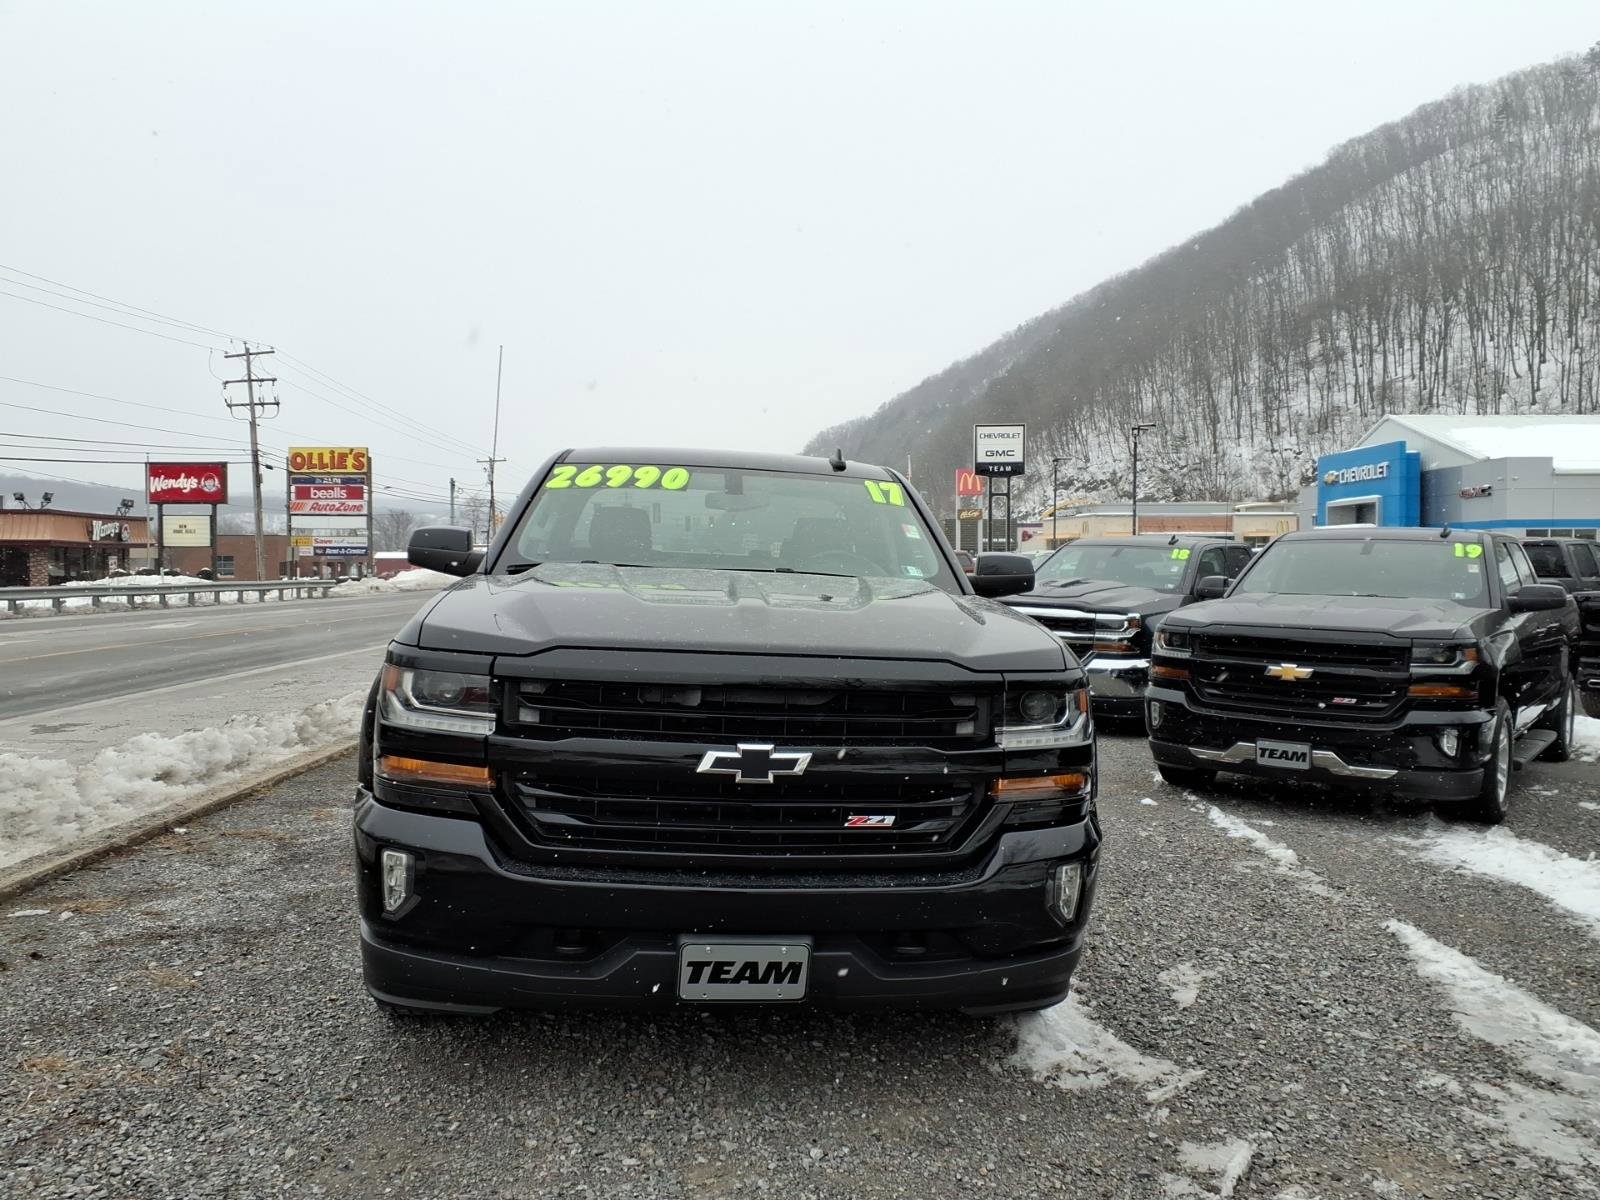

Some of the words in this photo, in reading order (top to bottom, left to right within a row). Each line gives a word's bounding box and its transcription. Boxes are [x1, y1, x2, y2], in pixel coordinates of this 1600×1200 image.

[979, 432, 1021, 440] CHEVROLET
[545, 465, 689, 489] 26990
[1339, 462, 1389, 483] CHEVROLET
[150, 472, 198, 493] Wendy's
[310, 487, 347, 499] bealls
[864, 480, 905, 506] 17
[309, 502, 363, 511] AutoZone
[92, 520, 120, 541] Wendy's
[1171, 548, 1191, 560] 18
[1454, 543, 1483, 558] 19
[1259, 747, 1307, 763] TEAM
[843, 815, 896, 827] Z71
[686, 961, 803, 984] TEAM
